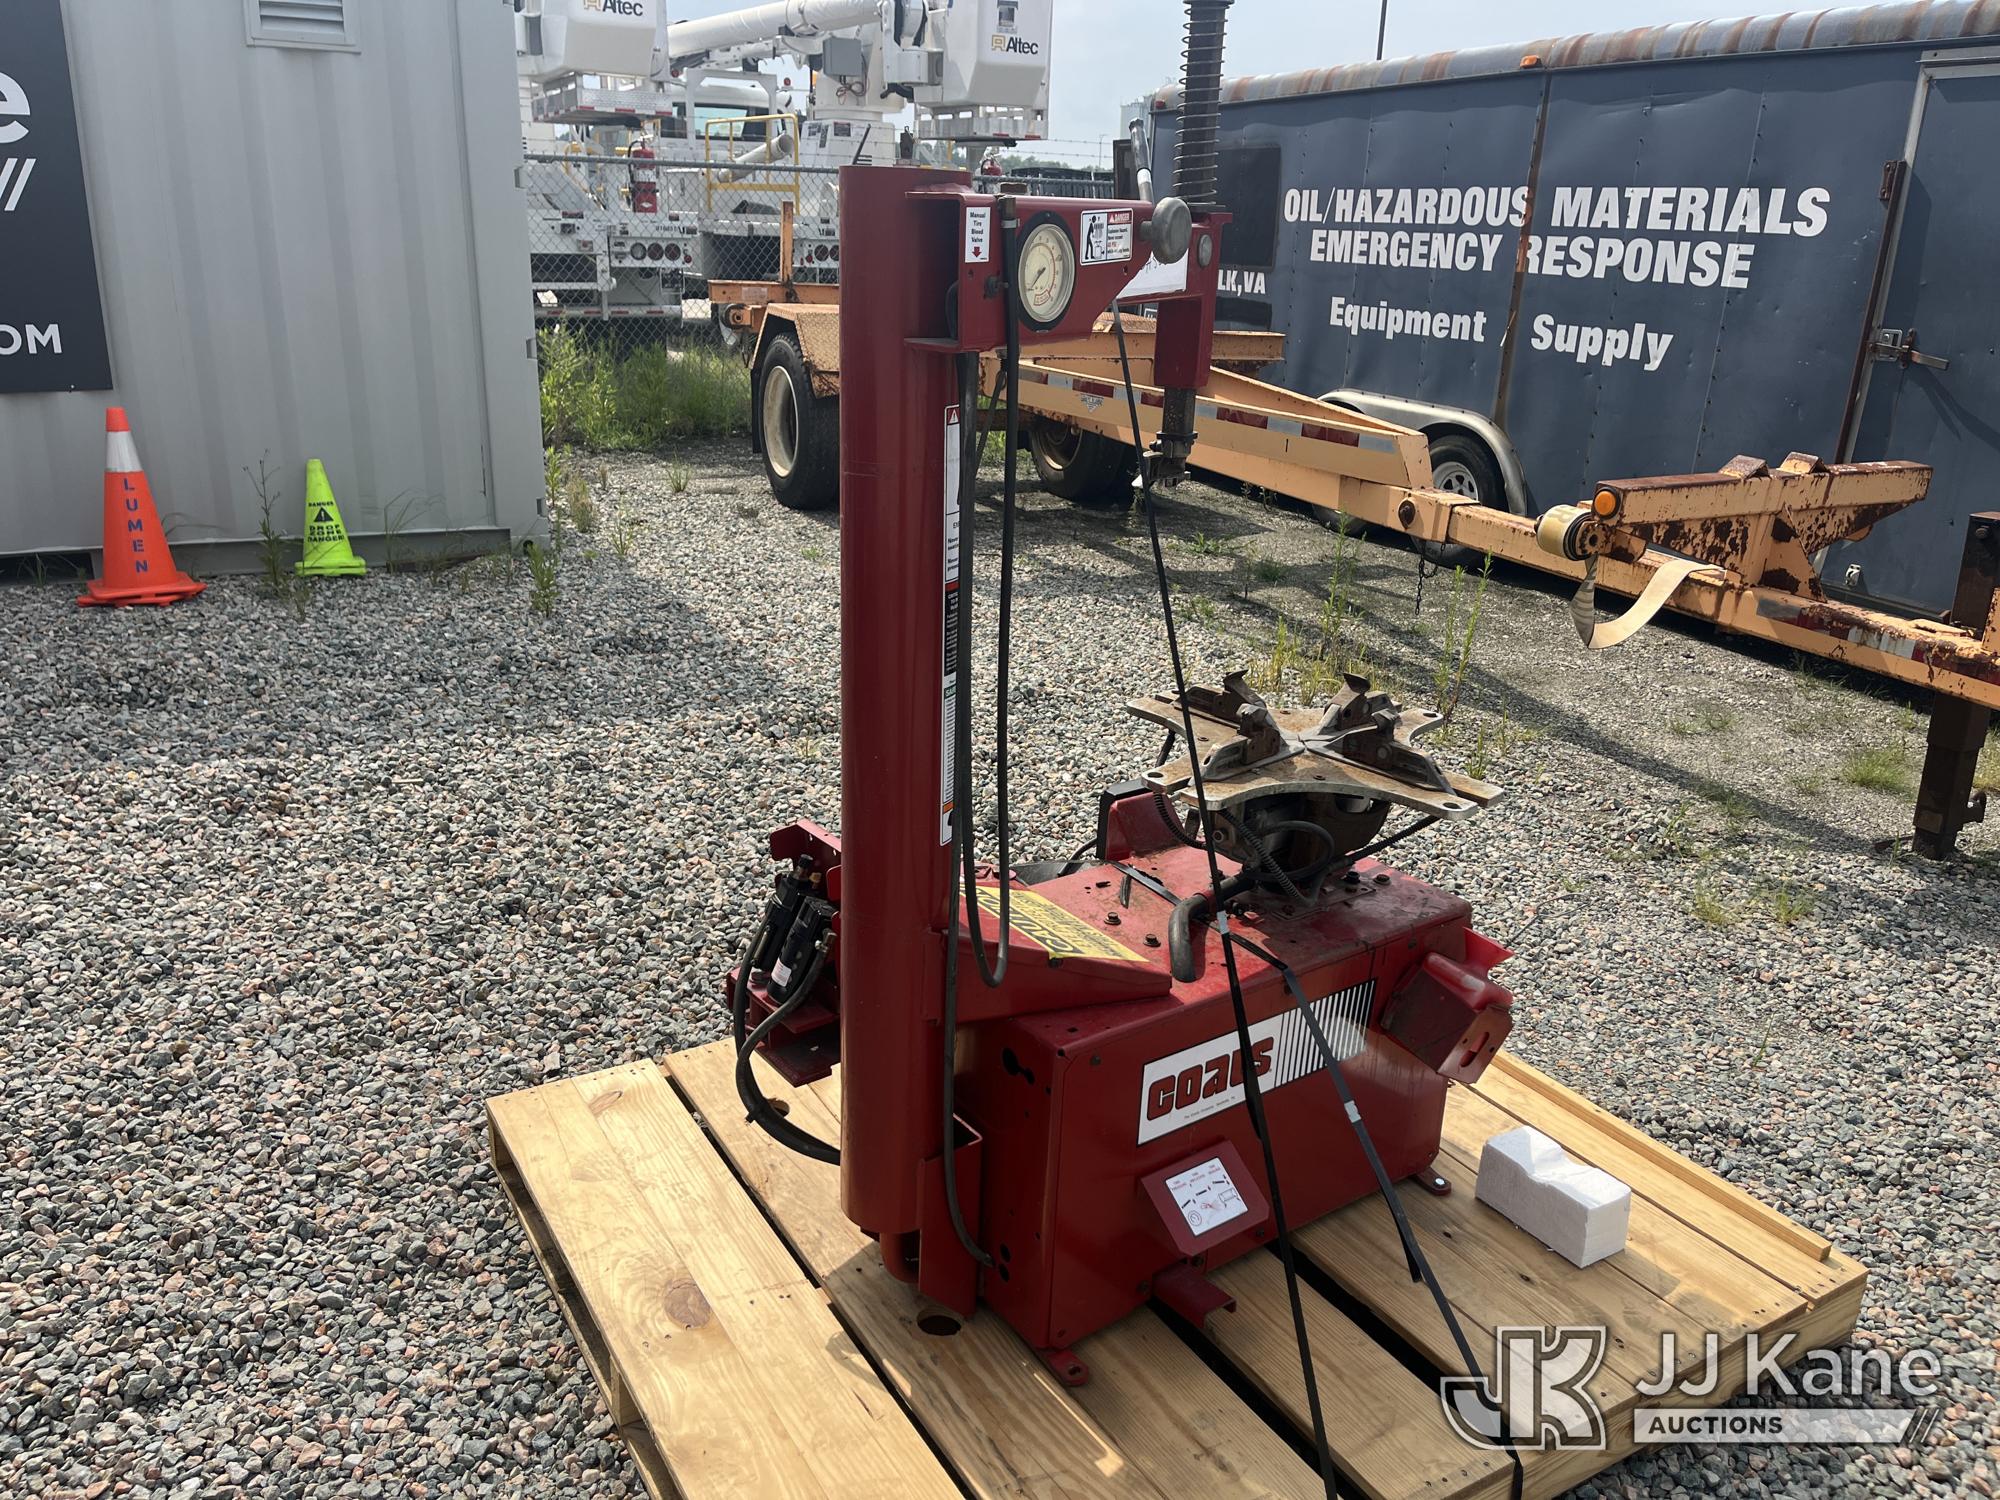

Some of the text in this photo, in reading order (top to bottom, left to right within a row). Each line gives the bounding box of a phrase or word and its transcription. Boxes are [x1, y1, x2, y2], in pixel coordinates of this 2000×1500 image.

[602, 0, 643, 17] Altec
[1006, 36, 1039, 55] Altec
[1283, 186, 1831, 237] OIL/HAZARDOUS MATERIALS
[1310, 230, 1756, 289] EMERGENCY RESPONSE
[1330, 296, 1674, 372] Equipment Supply
[123, 477, 149, 574] LUMEN
